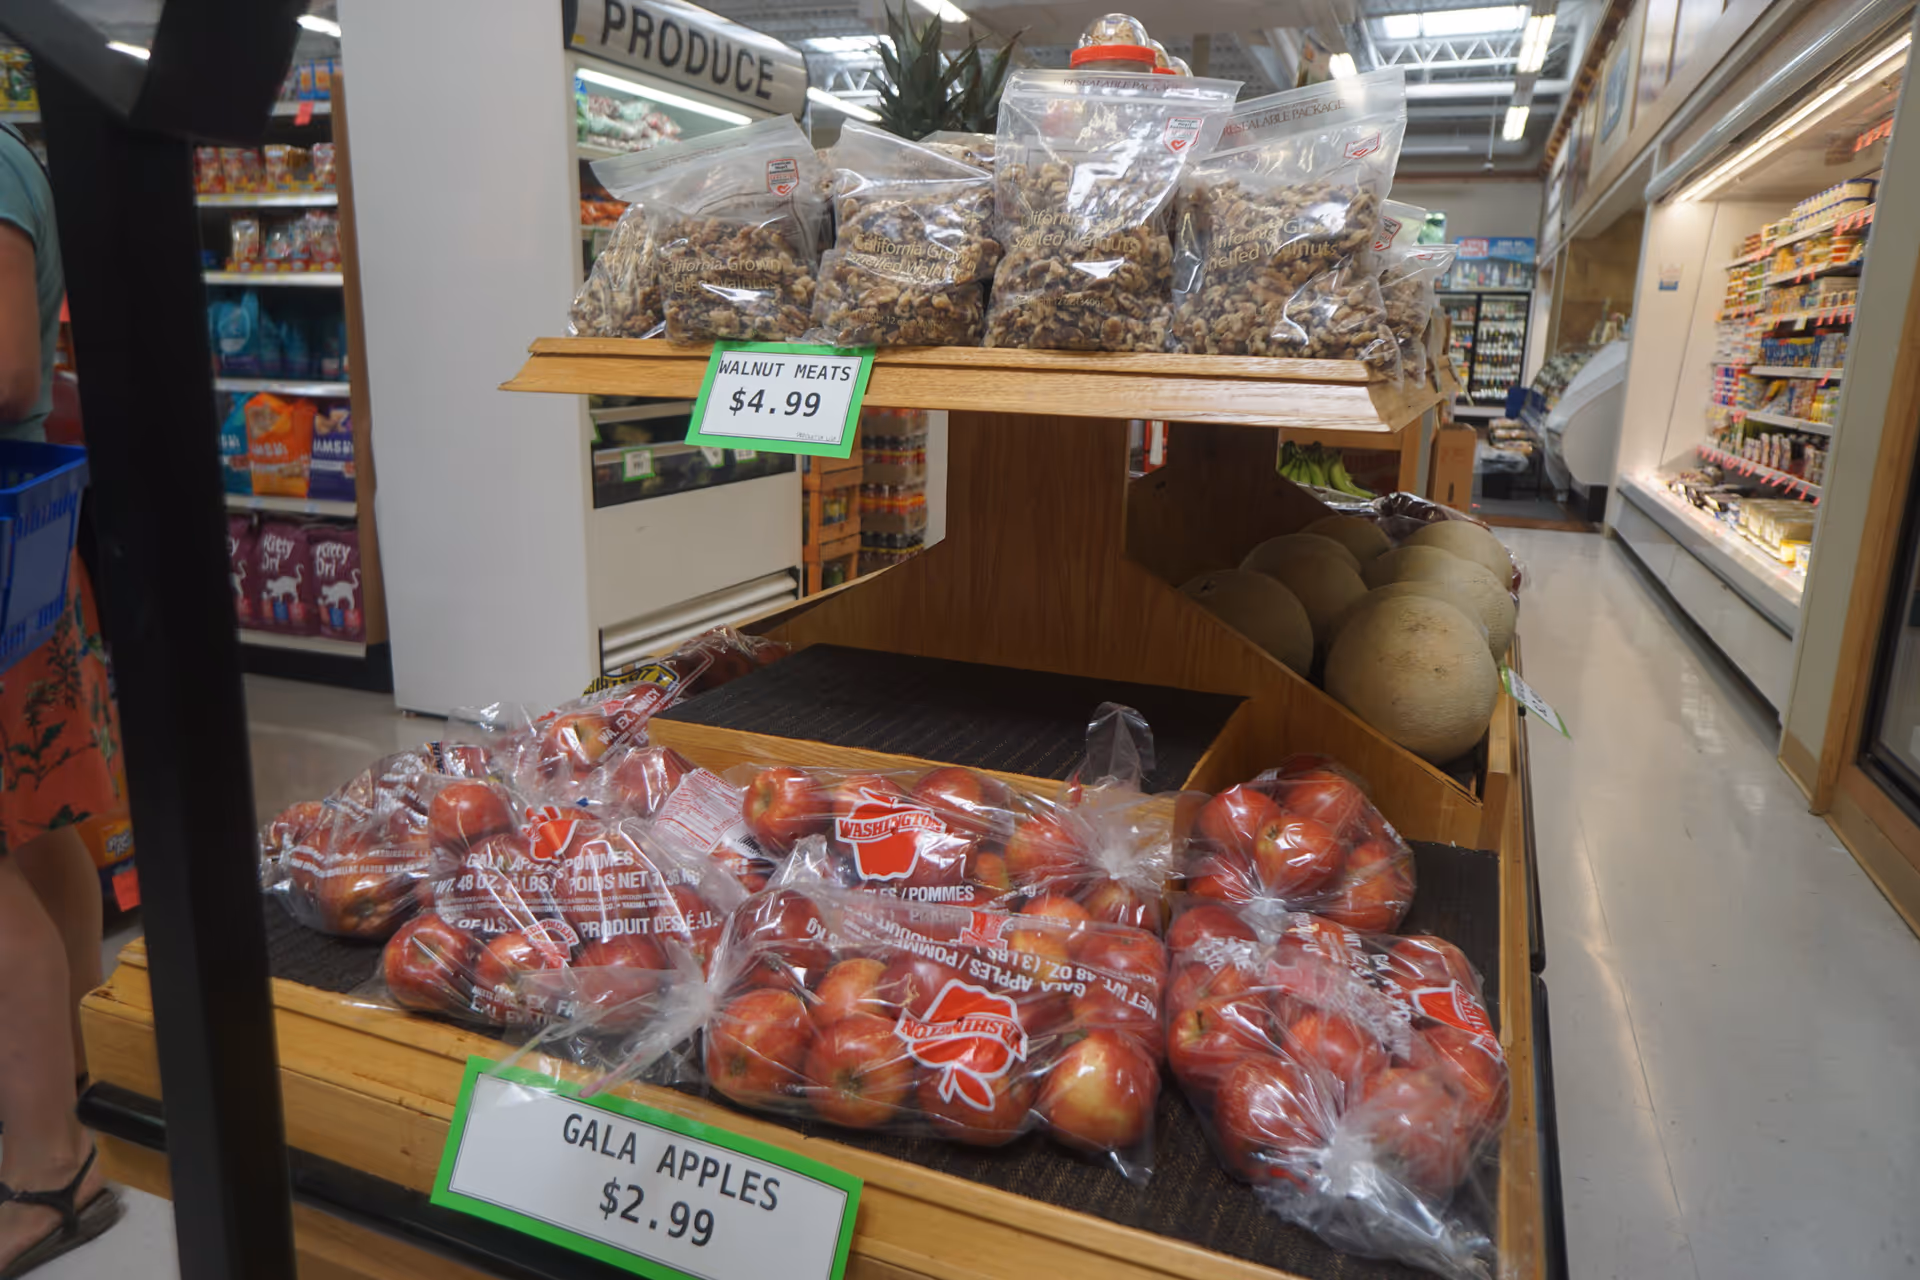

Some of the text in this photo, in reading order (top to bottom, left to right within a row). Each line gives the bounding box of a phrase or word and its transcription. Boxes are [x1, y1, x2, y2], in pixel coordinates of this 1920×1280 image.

[601, 1, 774, 100] PRODUCE
[854, 233, 922, 255] California
[727, 256, 782, 273] Grown
[718, 360, 852, 382] WALNUT MEATS
[729, 386, 822, 418] $4.99
[262, 532, 295, 561] Kitty
[615, 712, 636, 731] EX.
[838, 811, 943, 839] WASHINGTON
[457, 874, 474, 892] 48
[618, 871, 649, 889] NET
[909, 885, 975, 901] POMMES
[580, 917, 651, 939] PRODUIT
[969, 958, 1034, 993] APPLES
[1046, 959, 1073, 981] OZ.
[1076, 967, 1097, 982] 48
[1128, 988, 1158, 1020] NET
[563, 1113, 781, 1212] GALA APPLES
[599, 1176, 716, 1248] $2.99
